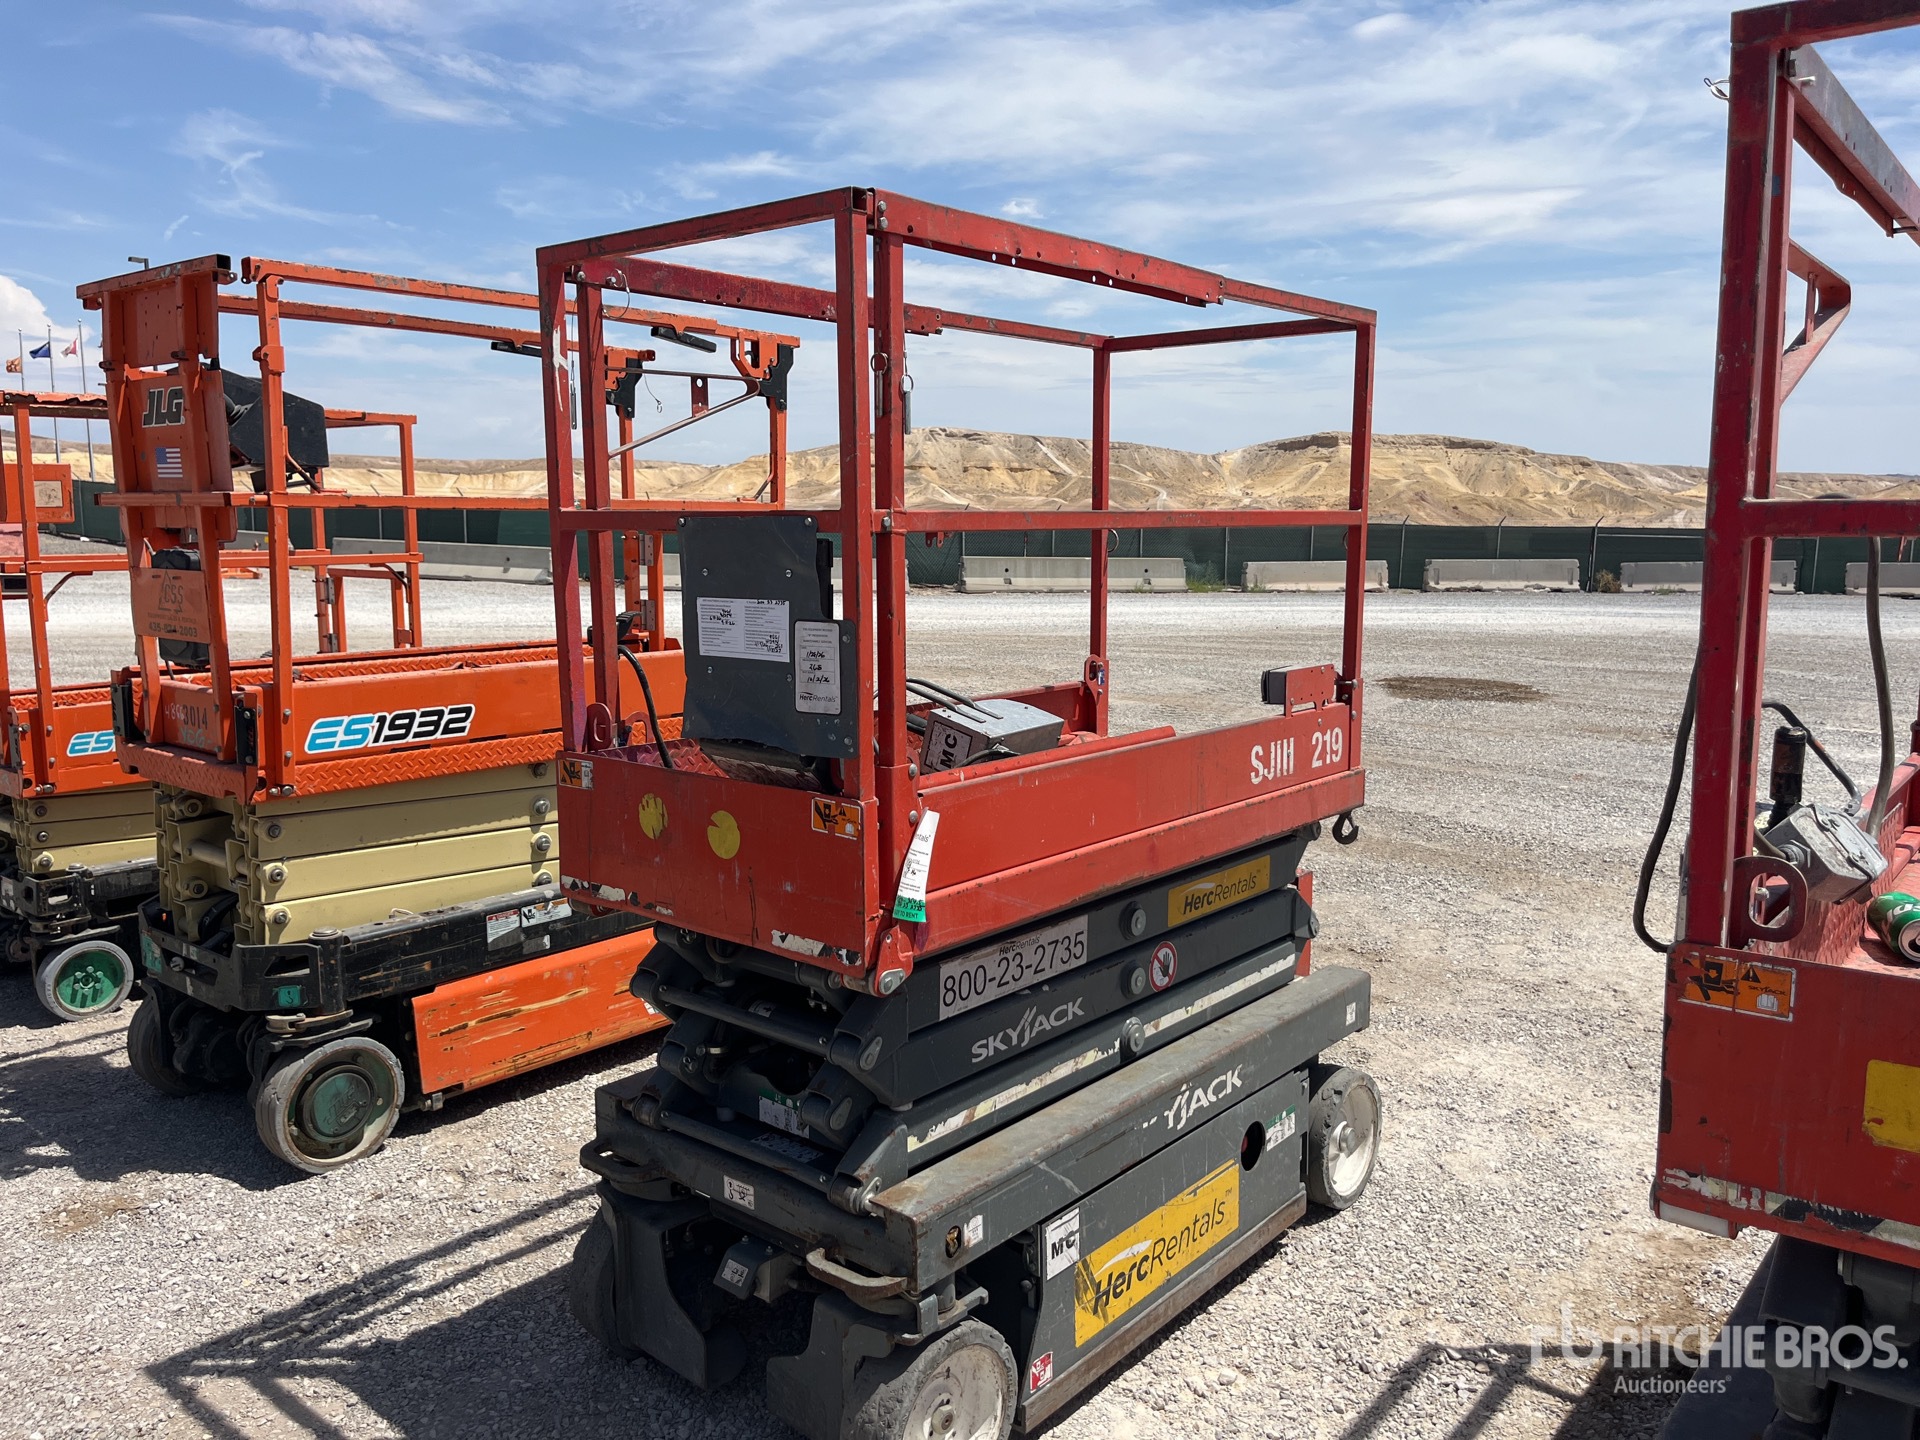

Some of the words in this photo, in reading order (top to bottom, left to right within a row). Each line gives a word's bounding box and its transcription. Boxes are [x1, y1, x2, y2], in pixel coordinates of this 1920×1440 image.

[142, 386, 184, 428] JLG
[164, 583, 184, 604] CSS
[305, 704, 474, 753] ES1932
[1311, 726, 1343, 769] 219
[1183, 872, 1257, 915] HercRentals
[942, 930, 1085, 1007] 800-23-2735
[999, 935, 1041, 956] HercRentals
[971, 996, 1085, 1063] SKYJACK
[1143, 1063, 1243, 1131] YJACK
[1093, 1198, 1226, 1316] HercRentals
